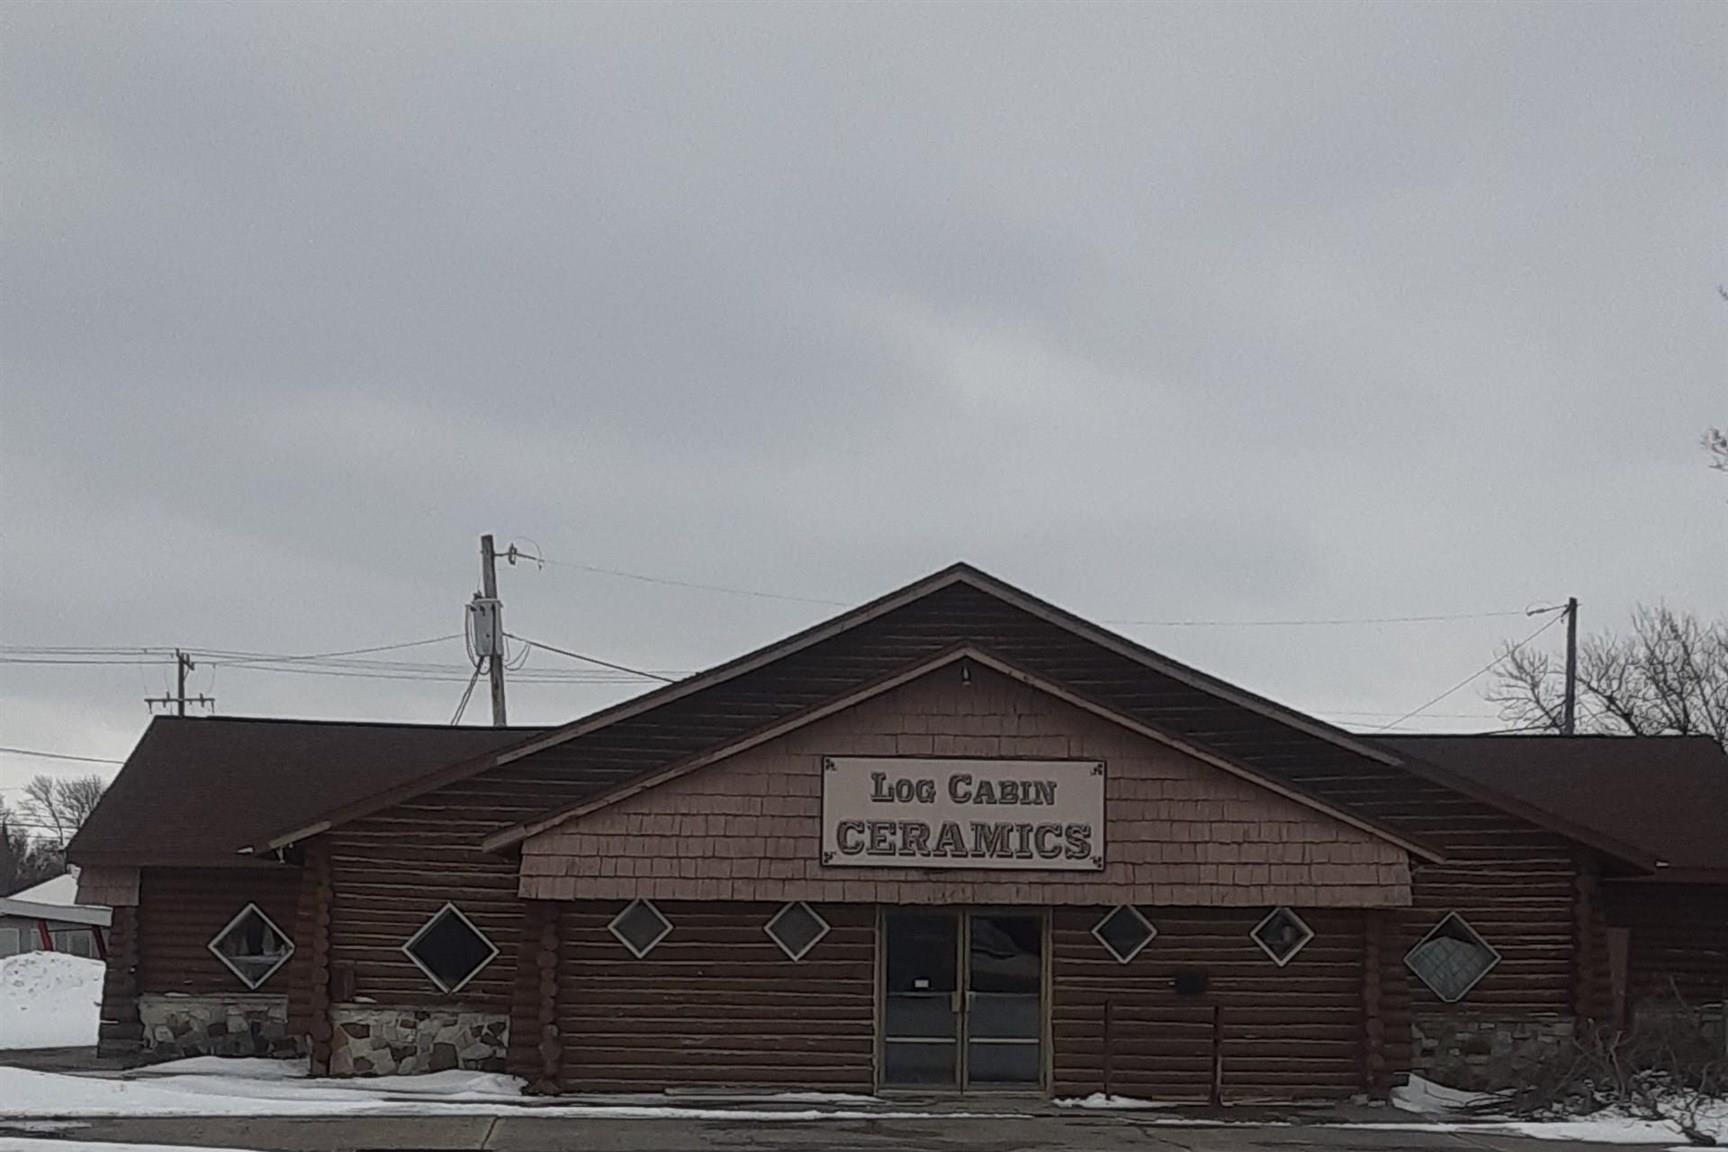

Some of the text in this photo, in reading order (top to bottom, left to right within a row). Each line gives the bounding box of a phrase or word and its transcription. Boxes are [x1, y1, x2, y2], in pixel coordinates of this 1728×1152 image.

[871, 772, 1057, 805] LOG CABIN
[836, 820, 1092, 860] CERAMICS
